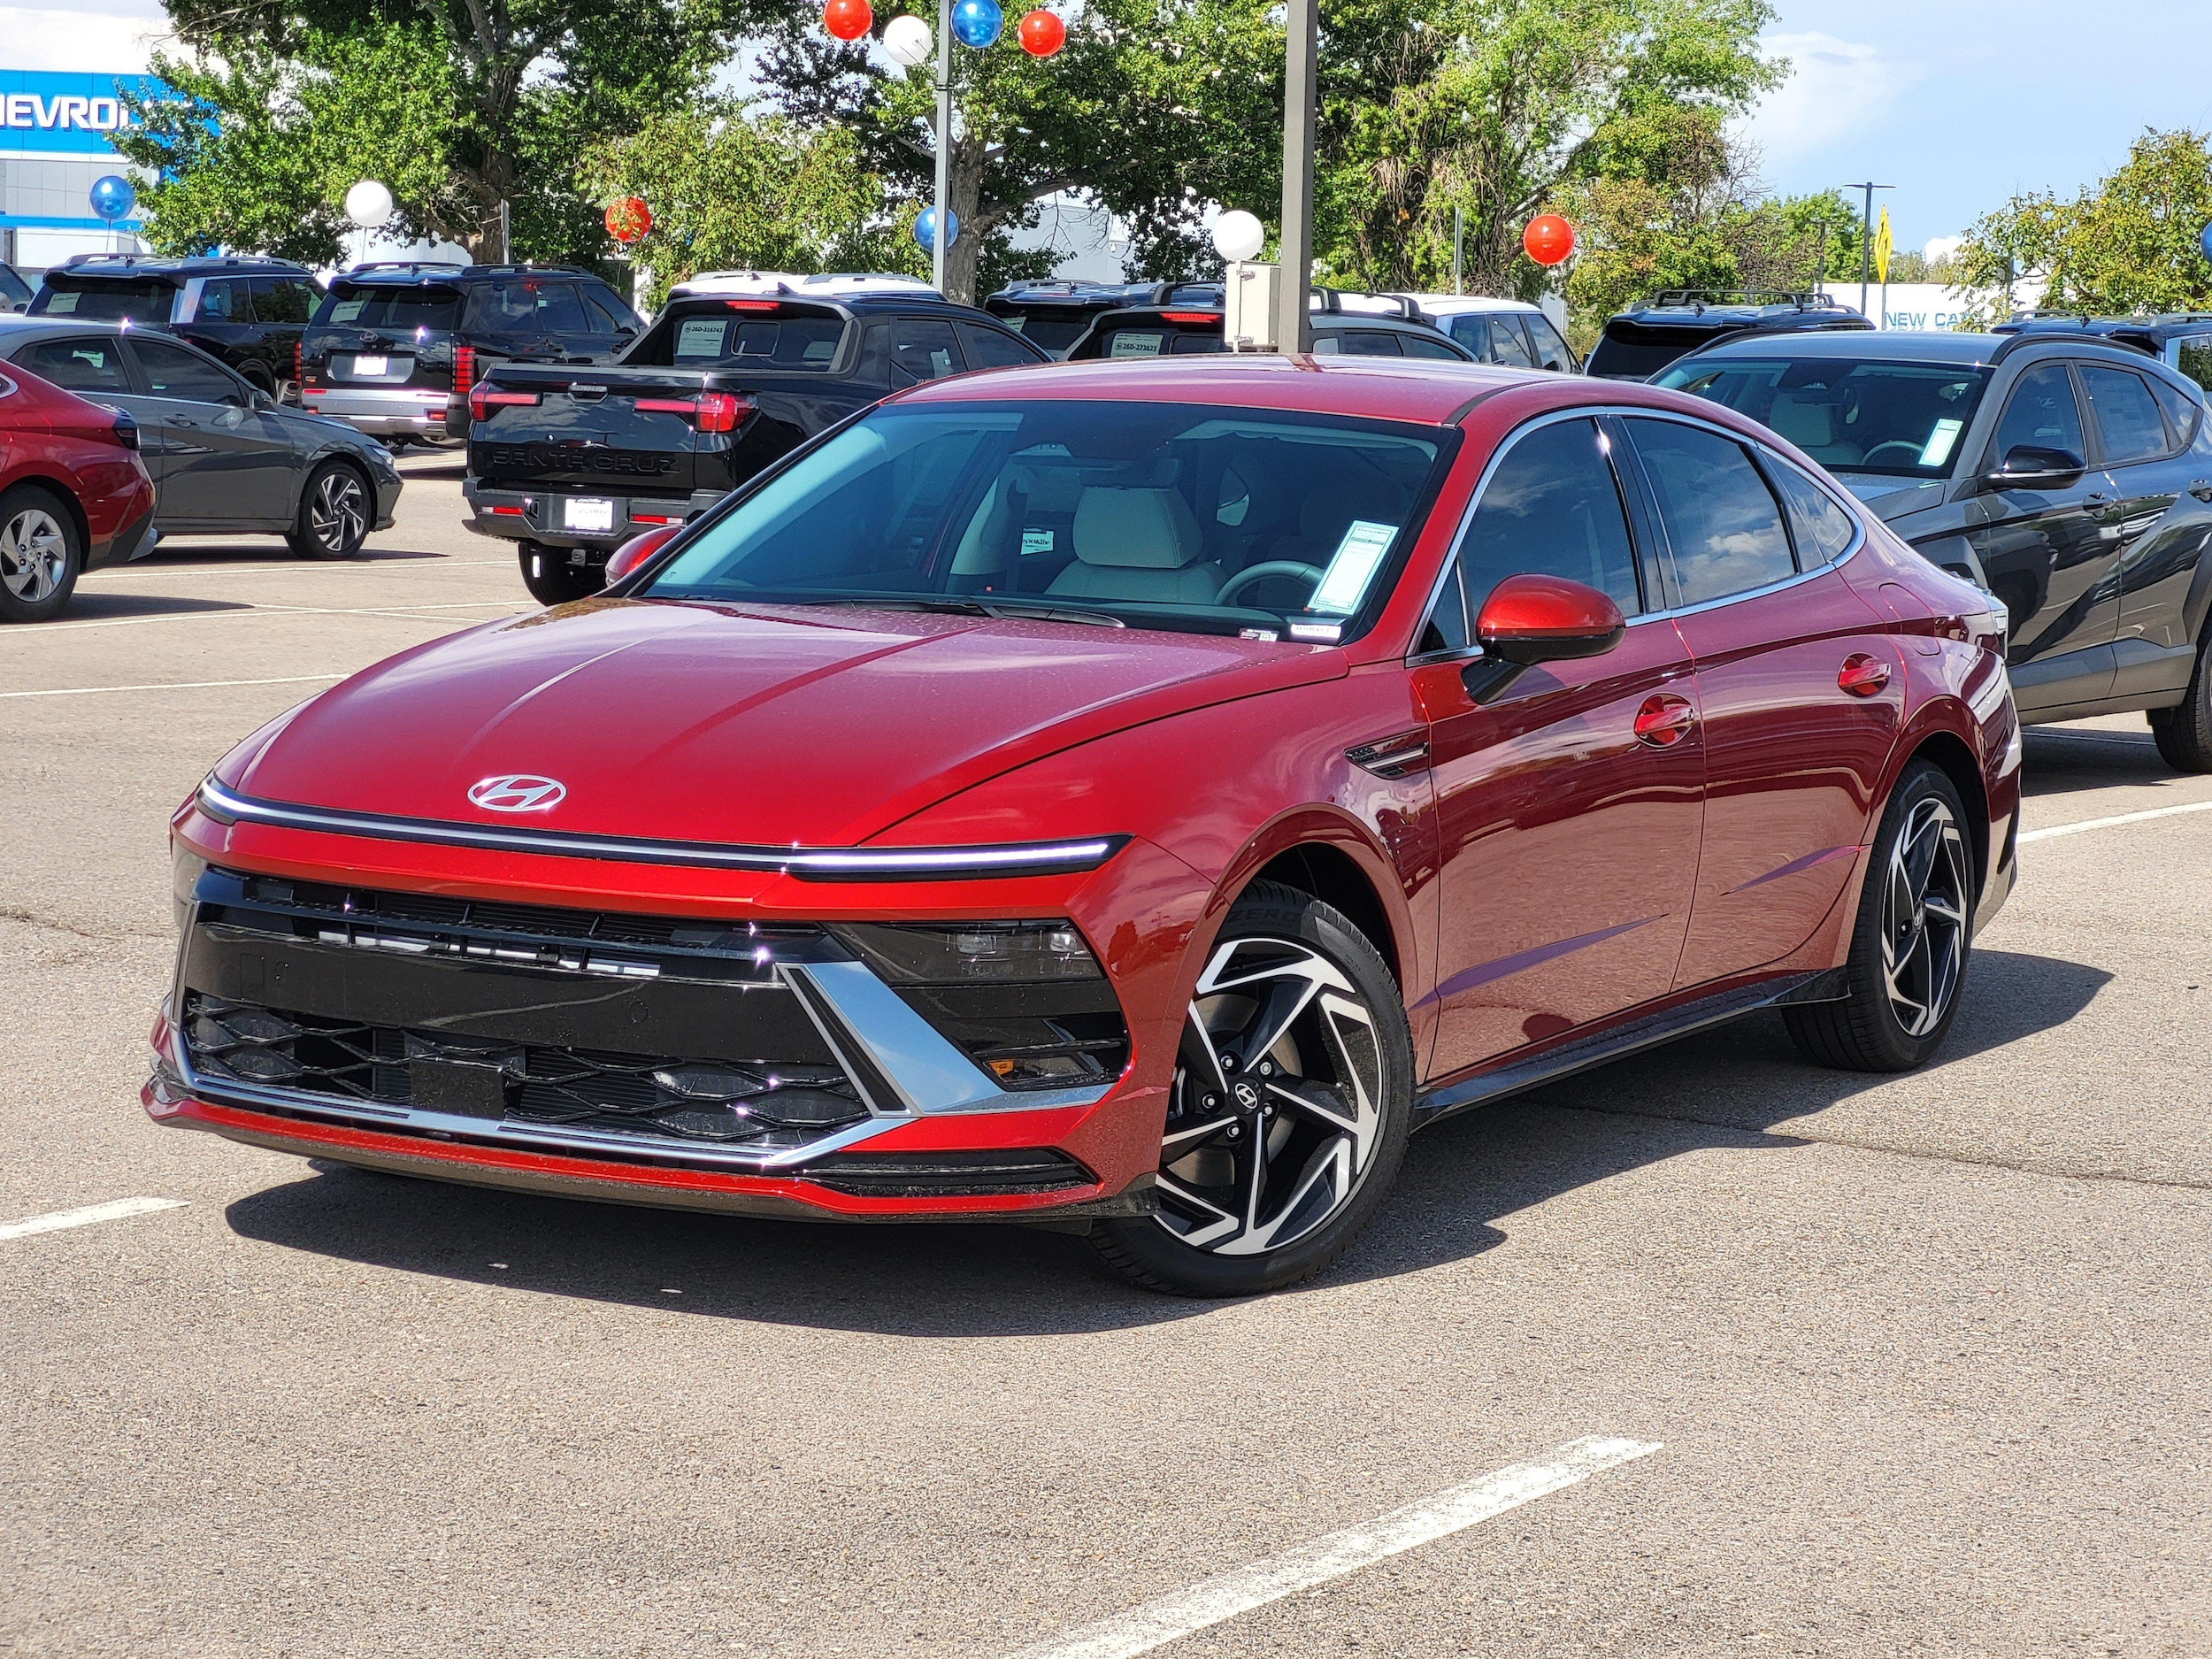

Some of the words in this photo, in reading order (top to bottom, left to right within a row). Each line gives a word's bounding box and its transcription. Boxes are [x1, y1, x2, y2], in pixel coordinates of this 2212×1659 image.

[1885, 311, 1927, 326] NEW
[492, 447, 586, 469] SANTA
[594, 452, 682, 473] CRUZ
